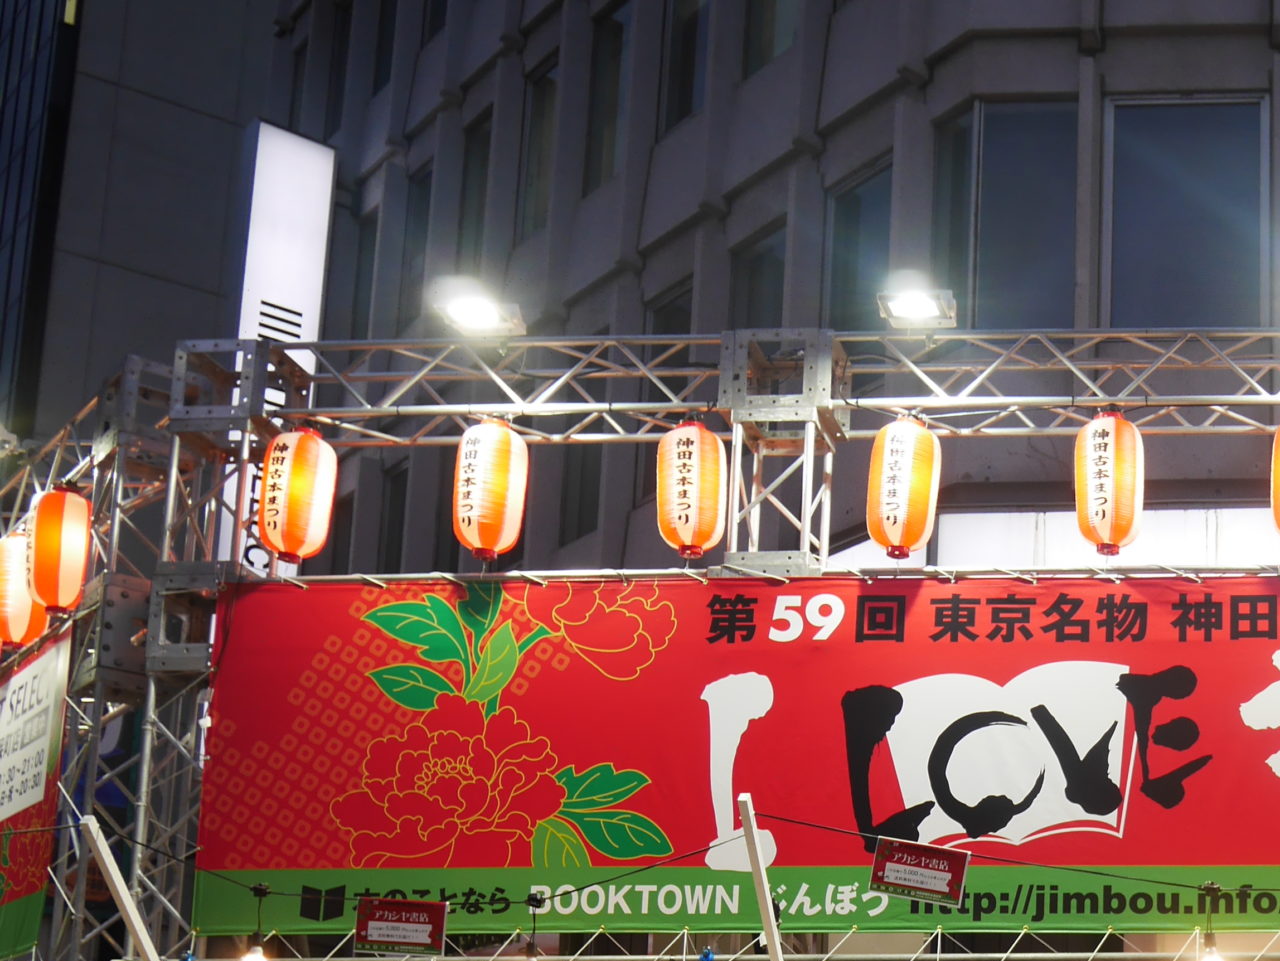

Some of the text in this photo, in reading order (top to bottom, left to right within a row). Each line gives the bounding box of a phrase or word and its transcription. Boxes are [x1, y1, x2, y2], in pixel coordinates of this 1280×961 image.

[267, 443, 289, 530] 神田古本まつり
[461, 437, 482, 527] 神田古本まつり
[676, 437, 695, 526] 神田古本まつり
[1091, 427, 1111, 521] 神田古本まつり
[707, 593, 906, 643] 第59回
[929, 592, 1149, 643] 東京名物
[700, 671, 778, 872] I
[841, 664, 1213, 854] LOVE
[529, 884, 741, 916] BOOKTOWN
[892, 852, 949, 871] アカシヤ書店
[374, 910, 429, 922] アカシヤ書店
